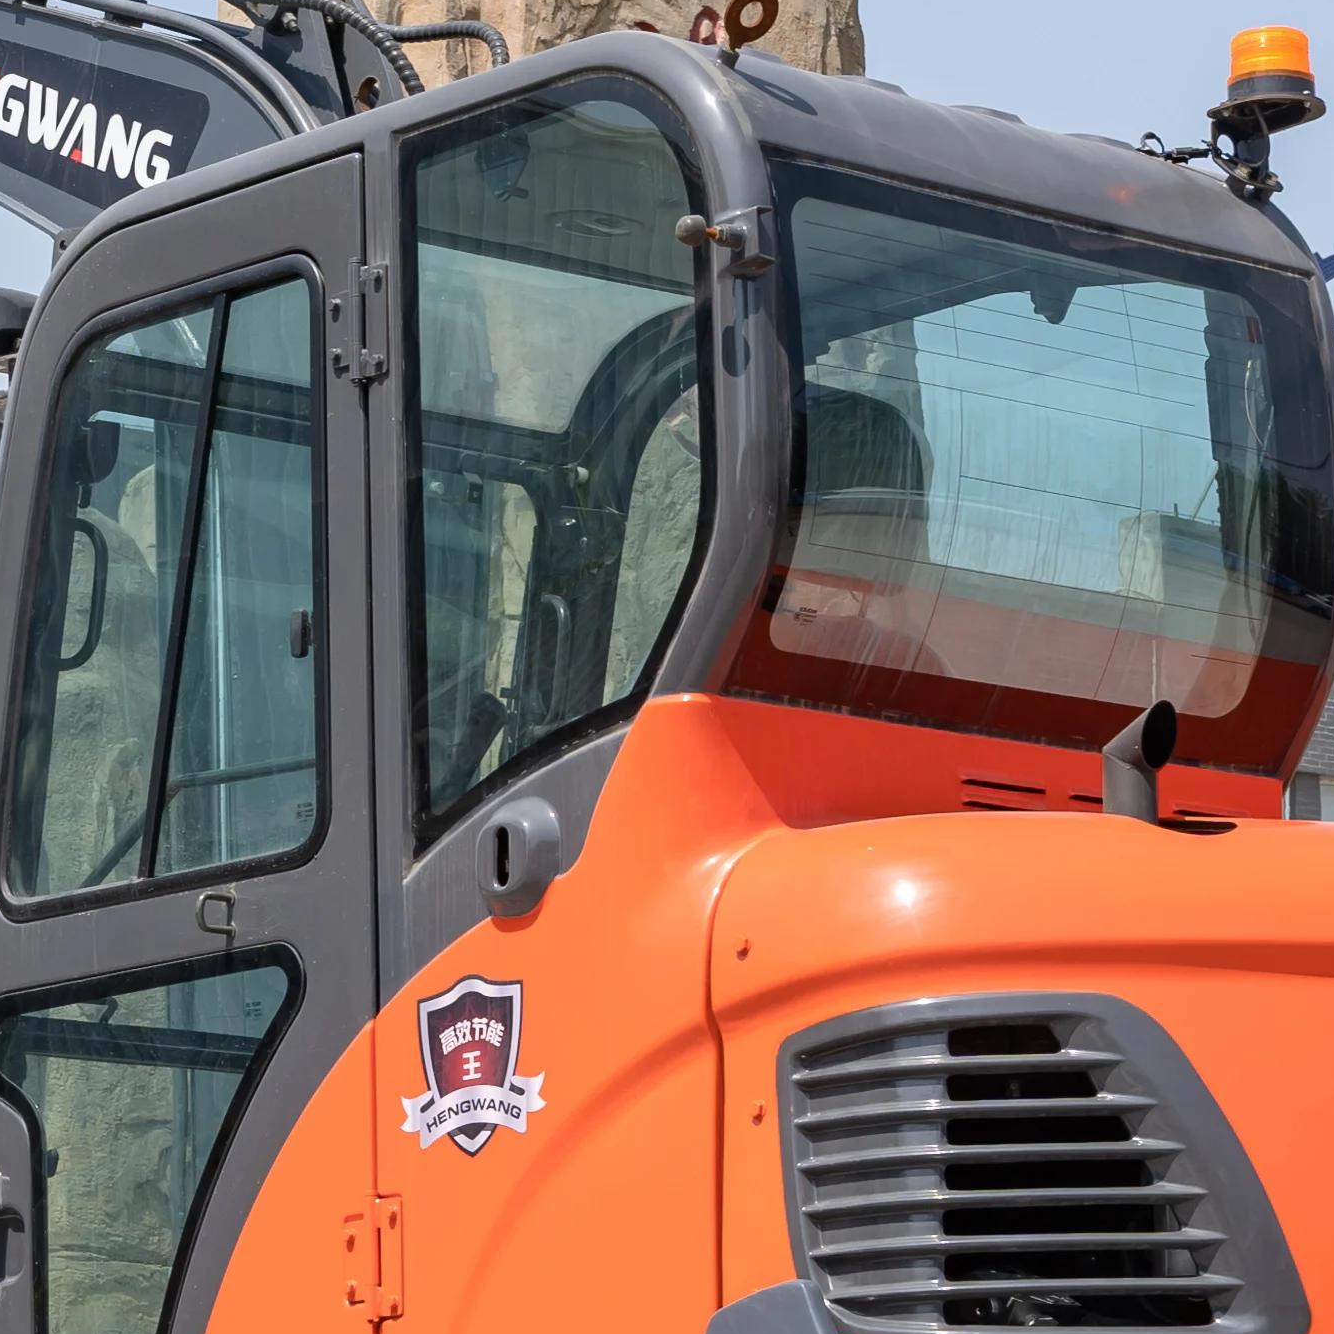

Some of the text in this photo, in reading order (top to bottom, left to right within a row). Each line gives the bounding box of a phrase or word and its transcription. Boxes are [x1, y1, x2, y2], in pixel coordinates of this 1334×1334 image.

[439, 1017, 505, 1056] 高效节能
[462, 1050, 482, 1081] 王
[426, 1098, 522, 1133] HENGWANG
